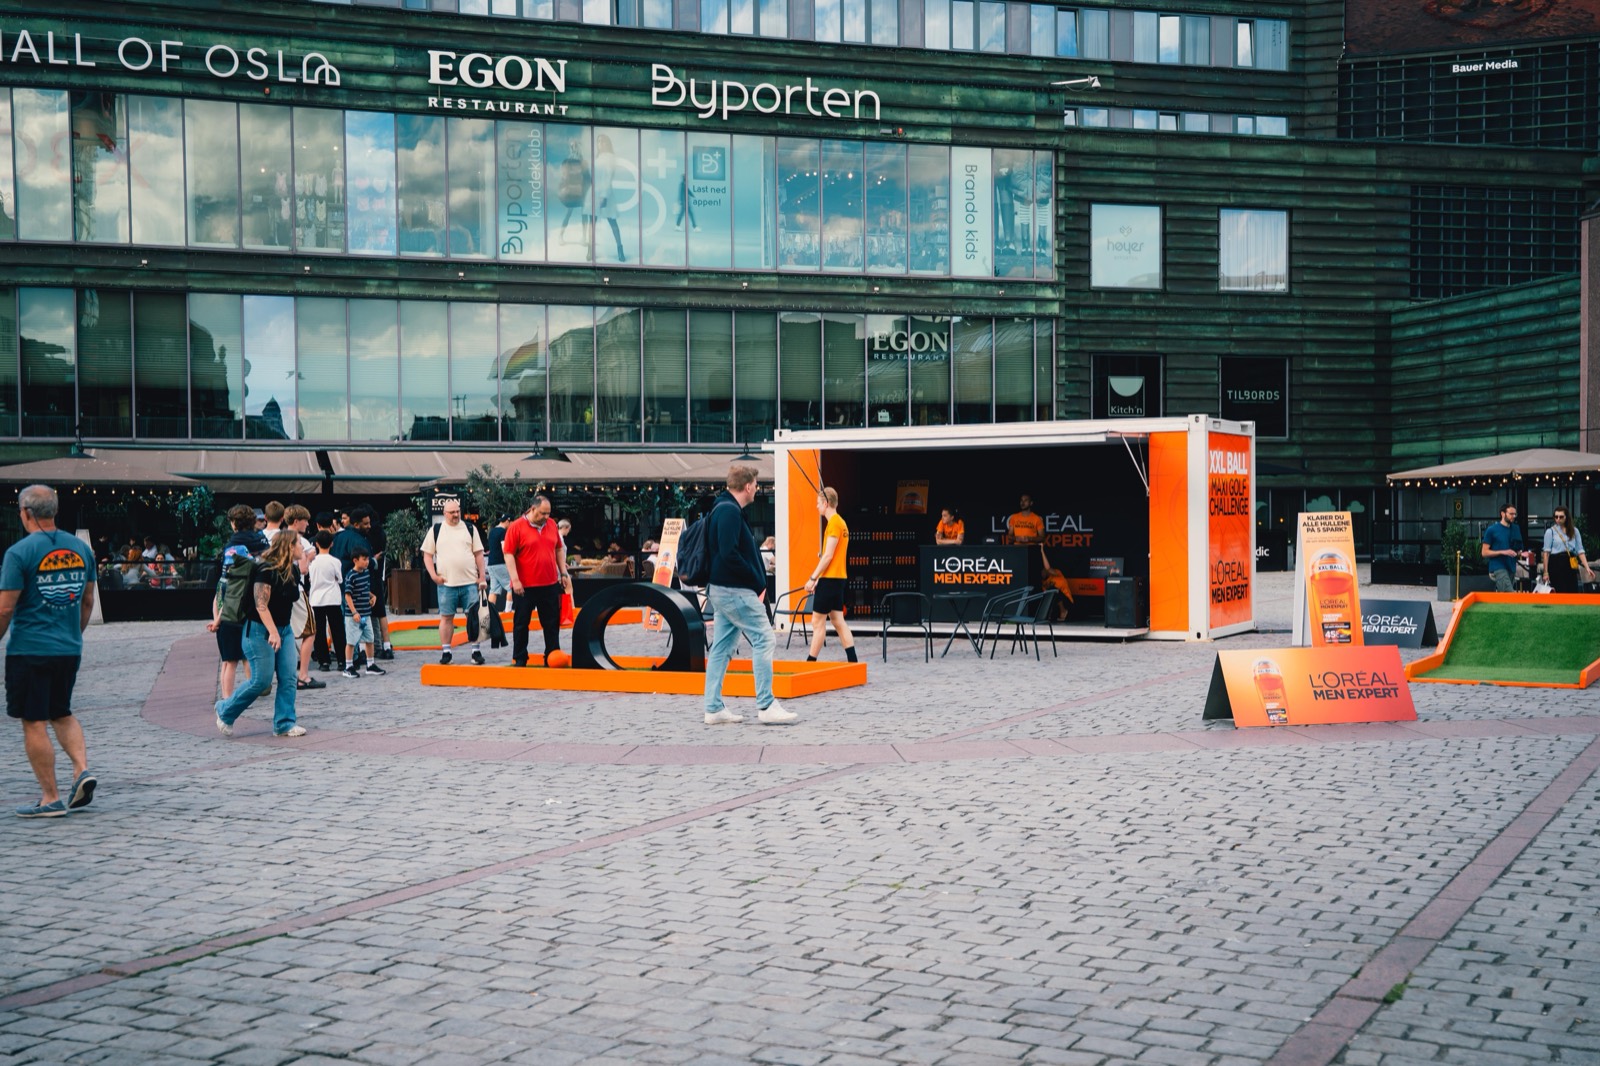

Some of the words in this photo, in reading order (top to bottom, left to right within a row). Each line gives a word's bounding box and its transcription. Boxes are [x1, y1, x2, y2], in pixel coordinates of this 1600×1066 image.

[0, 28, 96, 66] ALL
[118, 37, 183, 72] OF
[428, 50, 567, 93] EGON
[1452, 63, 1483, 73] Bauer
[1485, 60, 1518, 70] Media
[652, 63, 881, 120] Byporten
[428, 97, 568, 115] RESTAURANT
[528, 129, 542, 218] kundeklubb
[501, 127, 528, 255] Byporten
[692, 185, 708, 193] Last
[711, 186, 726, 194] ned
[965, 164, 978, 225] Brando
[692, 199, 721, 207] appen!
[965, 230, 978, 260] kids
[873, 330, 949, 352] EGON
[1227, 390, 1280, 401] TILBORDS
[1111, 405, 1142, 415] Kitch'n
[1209, 450, 1226, 474] XXL
[1227, 451, 1248, 475] BALL
[1211, 478, 1228, 496] MAXI
[1229, 478, 1247, 496] GOLF
[1209, 497, 1248, 516] CHALLENGE
[992, 513, 1093, 532] L'ÉAL
[934, 557, 1012, 573] L'ORÉAL
[36, 572, 85, 584] MAUI
[934, 573, 961, 584] MEN
[964, 573, 1013, 584] EXPERT
[1212, 587, 1226, 604] MEN
[1226, 584, 1248, 601] EXPERT
[1380, 625, 1417, 635] EXPERT
[1309, 671, 1397, 688] L'ORÉAL
[1313, 689, 1345, 700] MEN
[1347, 688, 1399, 699] EXPERT
